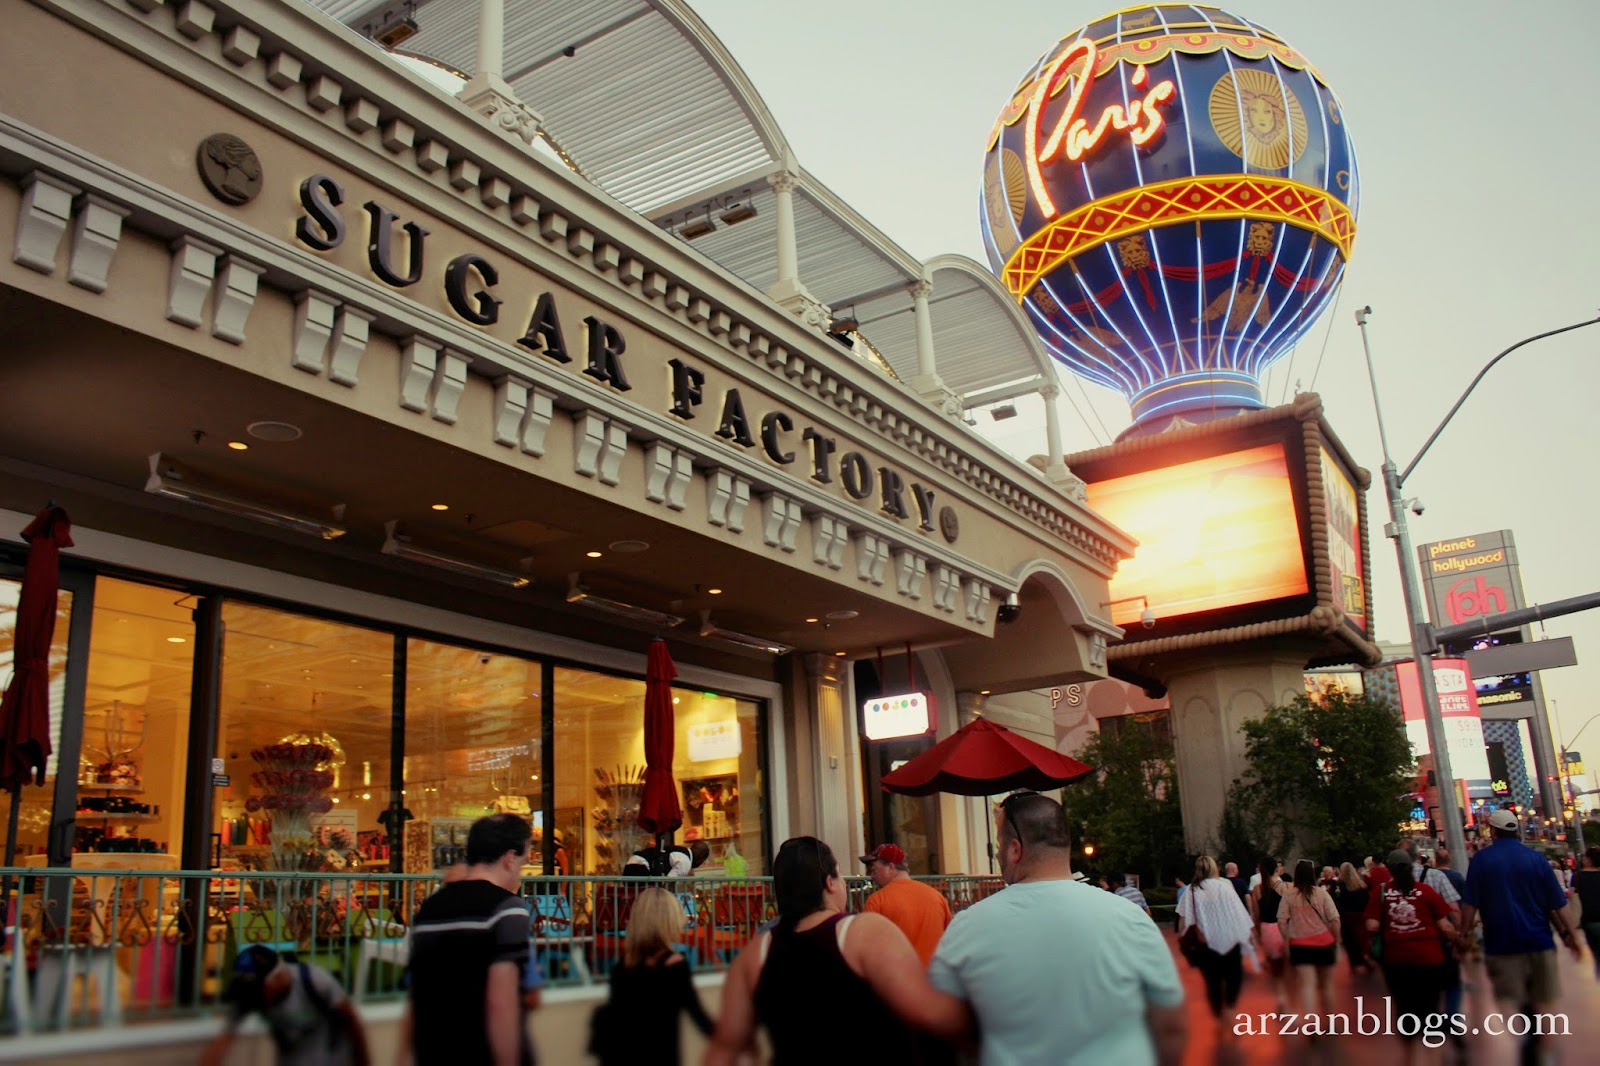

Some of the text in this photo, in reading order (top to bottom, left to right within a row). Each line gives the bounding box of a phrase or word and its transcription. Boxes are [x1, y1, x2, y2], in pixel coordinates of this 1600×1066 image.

[1024, 37, 1178, 220] Paris
[296, 174, 936, 533] SUGAR FACTORY
[1429, 537, 1476, 558] planet
[1432, 550, 1503, 573] hollywood
[1445, 575, 1508, 625] ph
[1476, 690, 1523, 705] nasonic
